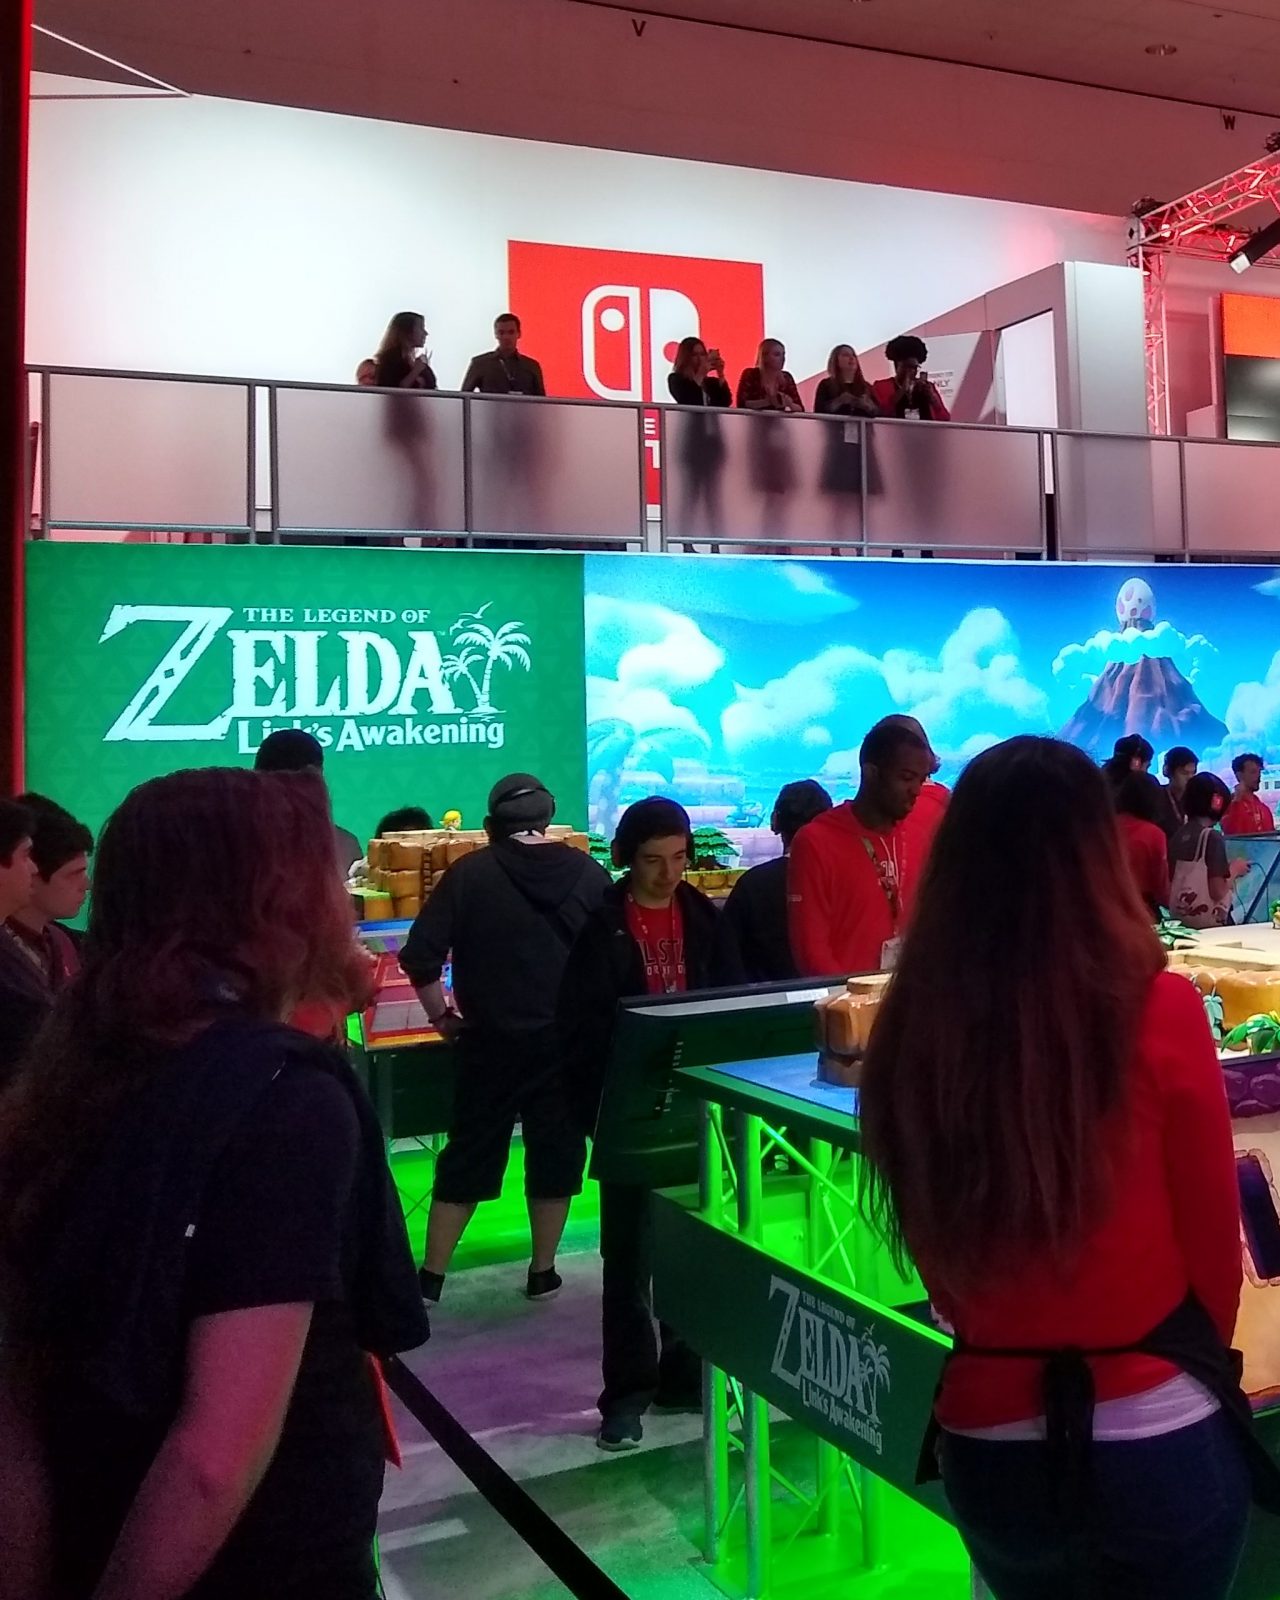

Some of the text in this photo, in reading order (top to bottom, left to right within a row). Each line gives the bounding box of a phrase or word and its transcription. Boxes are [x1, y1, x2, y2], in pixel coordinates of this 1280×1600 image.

[631, 18, 647, 37] V
[1222, 114, 1236, 130] W
[243, 607, 431, 624] THE LEGEND OF
[99, 604, 464, 742] ZELDA
[238, 716, 504, 754] Li's Awakening
[768, 1274, 871, 1417] ZELDA
[829, 1396, 882, 1455] Awakening
